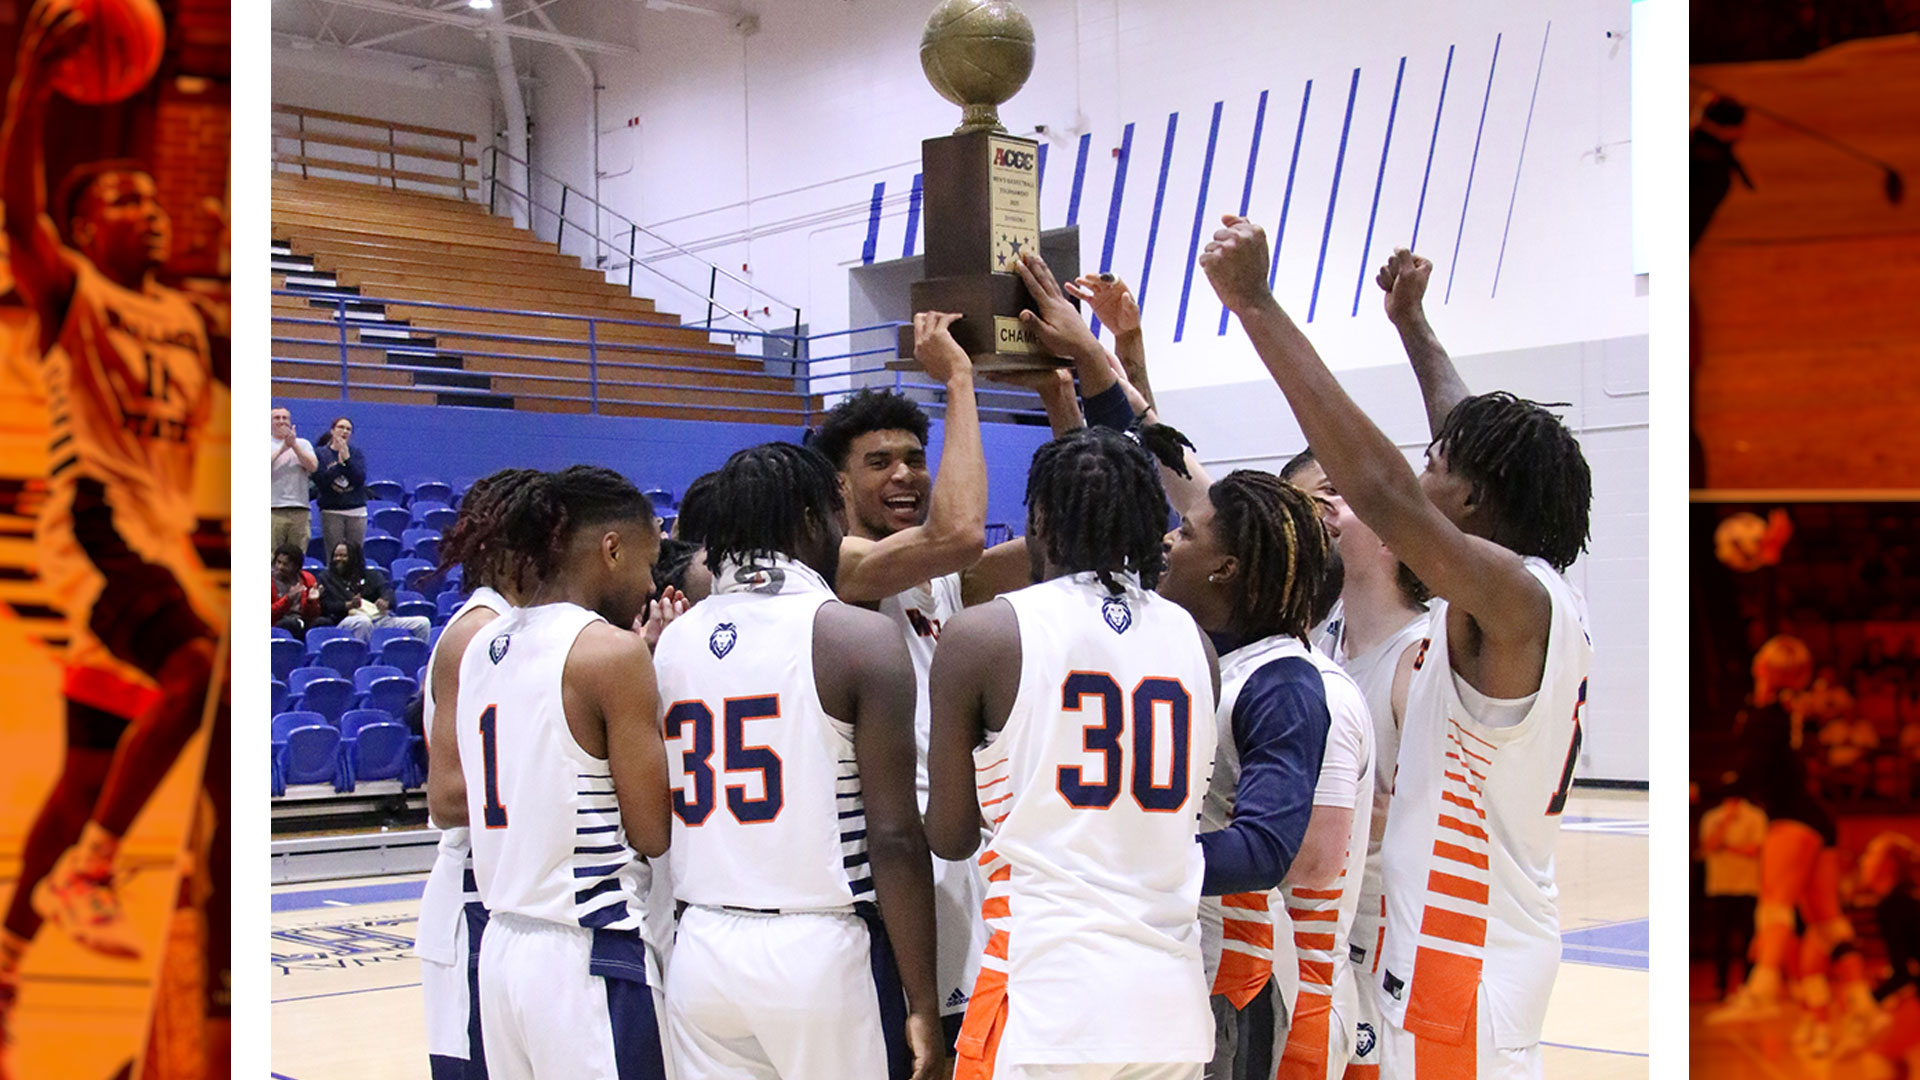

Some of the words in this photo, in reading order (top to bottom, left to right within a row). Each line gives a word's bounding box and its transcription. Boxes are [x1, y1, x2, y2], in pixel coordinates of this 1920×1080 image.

[479, 703, 508, 830] 1
[664, 693, 785, 828] 35
[1055, 669, 1192, 814] 30
